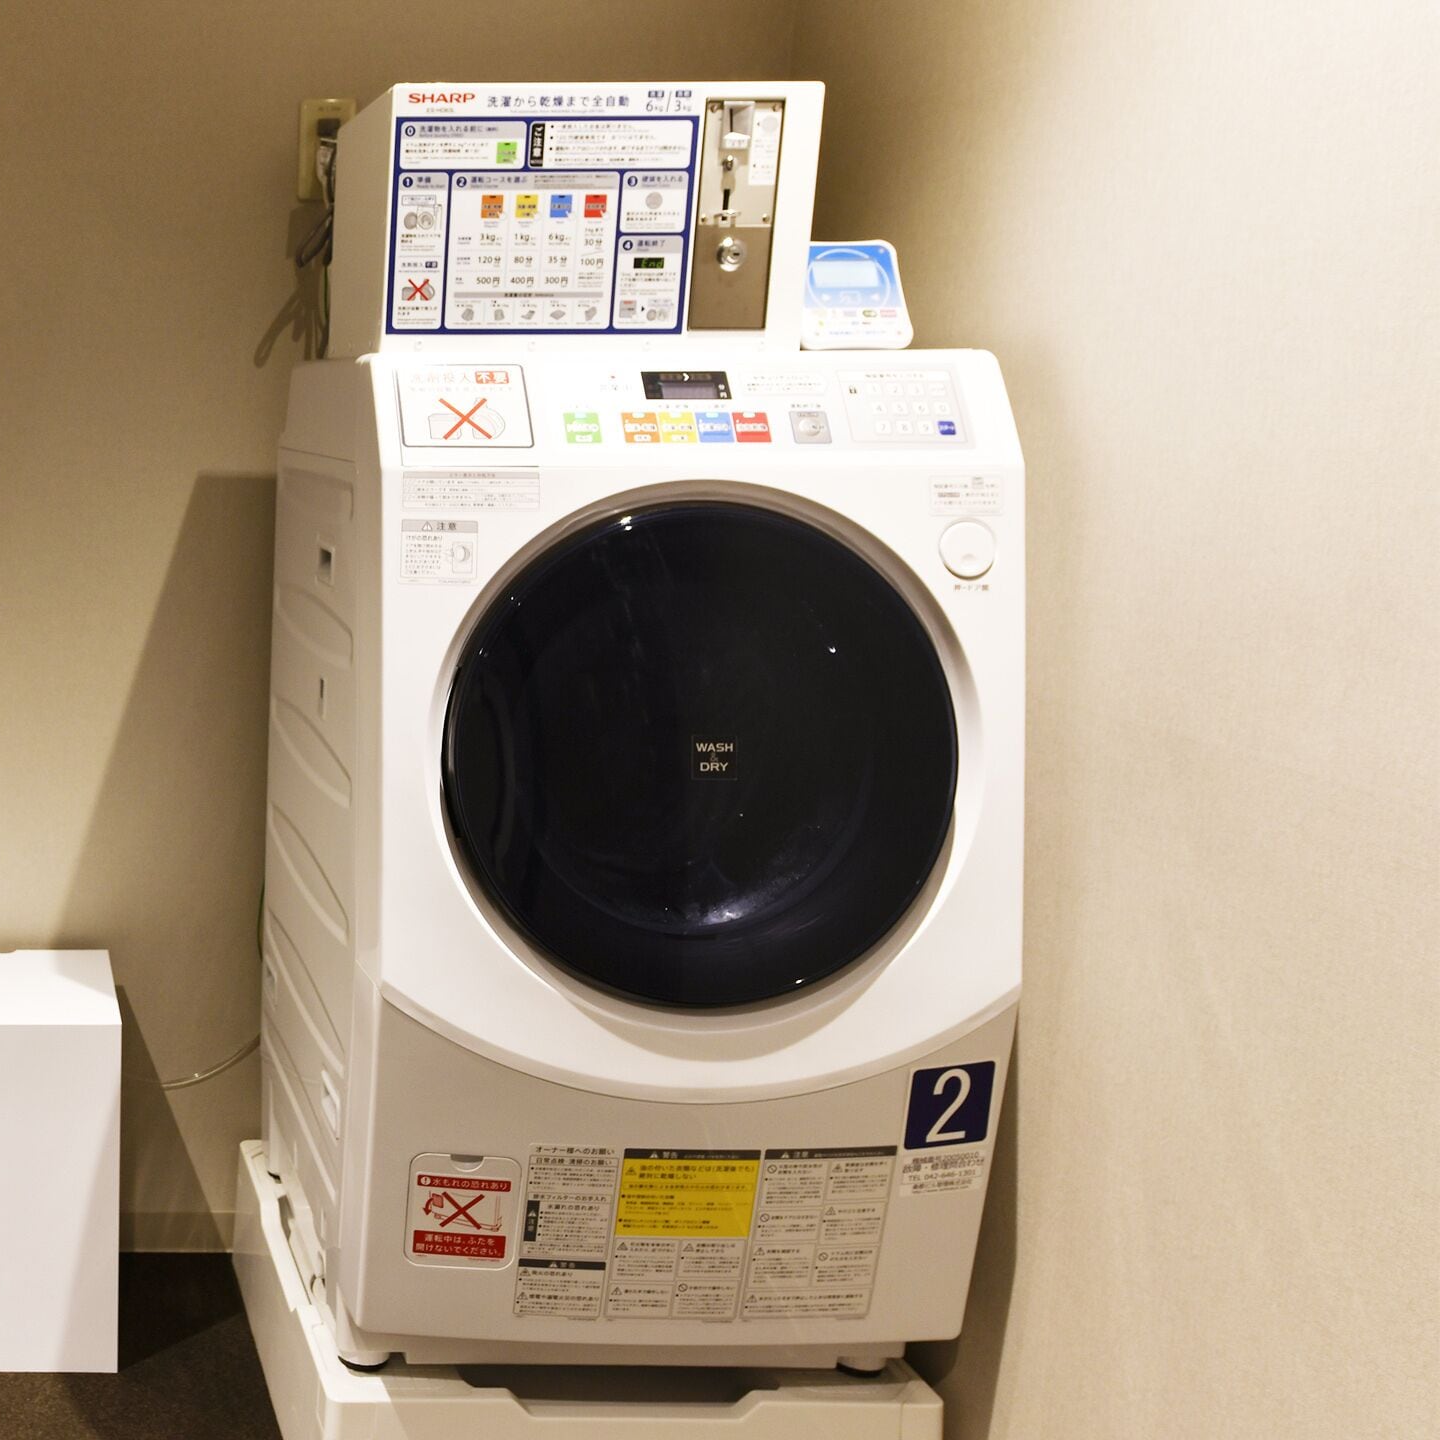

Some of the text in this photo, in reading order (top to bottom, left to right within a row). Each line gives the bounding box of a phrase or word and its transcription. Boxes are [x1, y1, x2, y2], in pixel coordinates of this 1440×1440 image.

[408, 93, 475, 103] SHARP
[487, 95, 630, 107] 洗濯から乾燥まで全自動
[436, 522, 457, 531] 注意
[696, 742, 734, 752] WASH
[700, 762, 728, 772] DRY
[926, 1068, 971, 1143] 2
[536, 1146, 615, 1155] オーナー様へのお願い
[432, 1177, 509, 1191] 水もれの恐れあり
[415, 1243, 503, 1256] 開けないでください。
